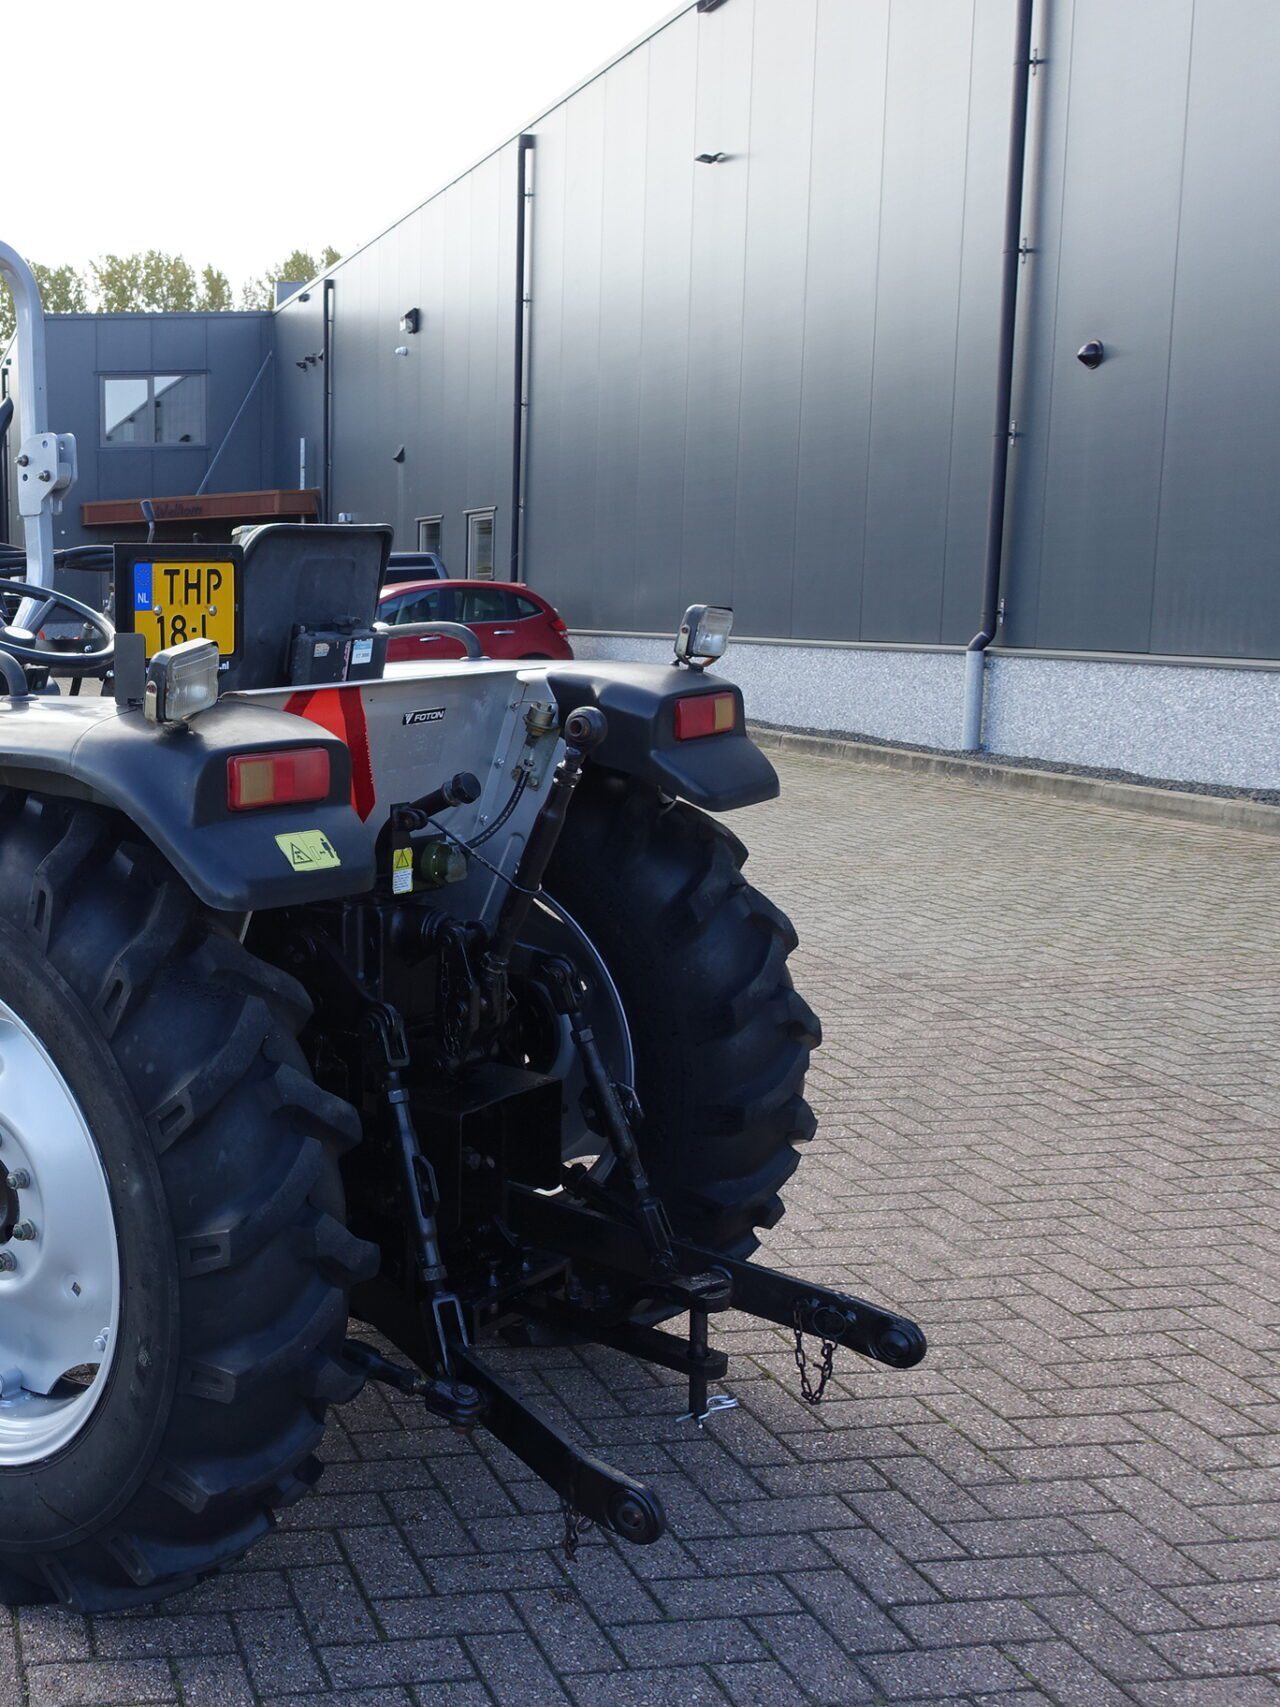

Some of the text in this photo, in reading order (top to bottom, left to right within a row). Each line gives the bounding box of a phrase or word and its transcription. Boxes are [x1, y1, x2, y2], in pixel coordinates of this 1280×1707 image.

[163, 568, 223, 605] THP
[137, 592, 149, 604] NL
[413, 710, 445, 722] FOTON
